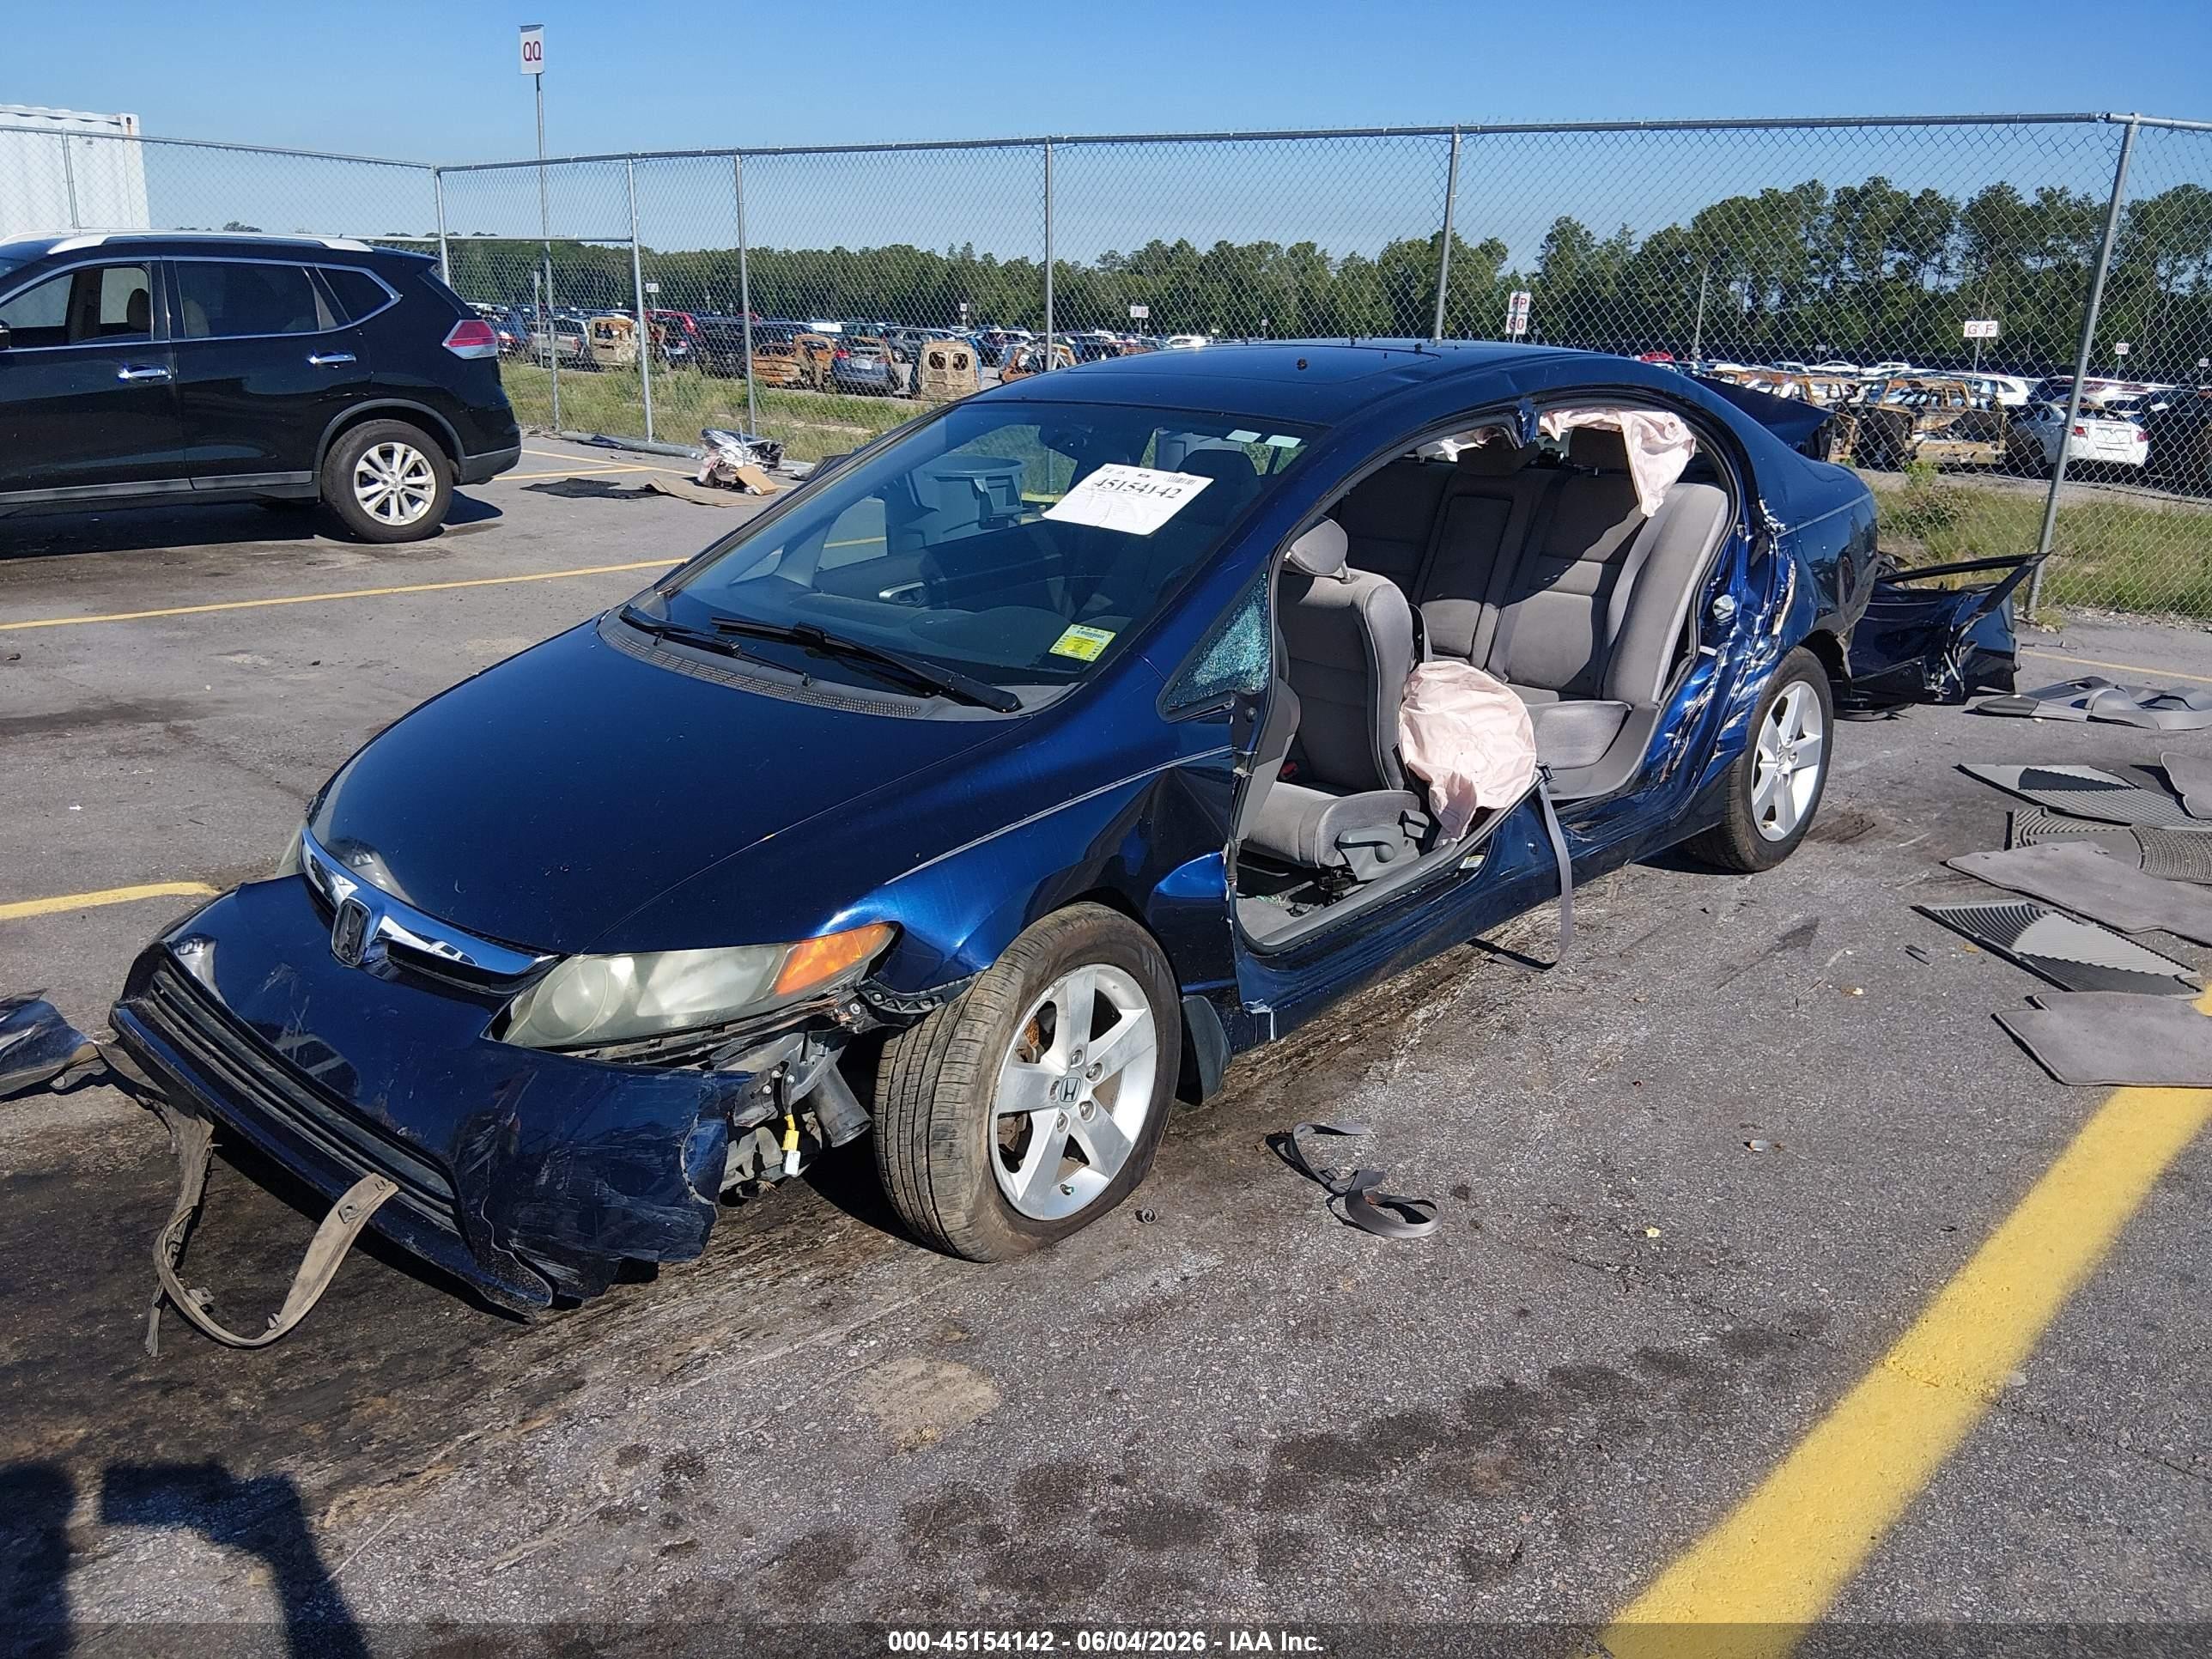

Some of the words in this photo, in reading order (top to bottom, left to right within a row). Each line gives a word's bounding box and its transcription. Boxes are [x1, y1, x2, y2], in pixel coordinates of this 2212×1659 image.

[523, 40, 542, 61] QQ
[1967, 324, 1978, 335] G
[1985, 324, 1993, 334] F
[1094, 478, 1182, 498] 45154142
